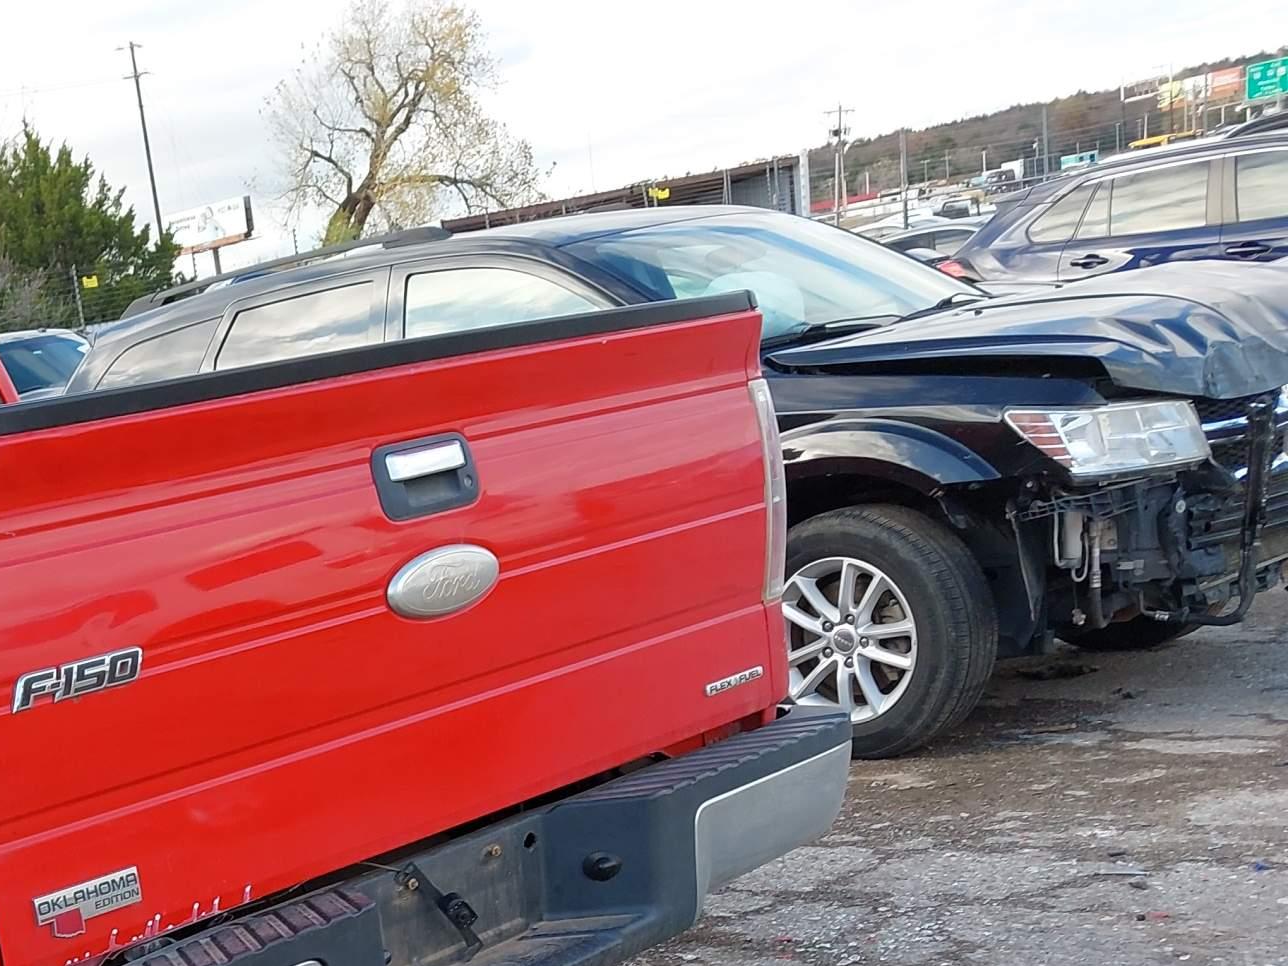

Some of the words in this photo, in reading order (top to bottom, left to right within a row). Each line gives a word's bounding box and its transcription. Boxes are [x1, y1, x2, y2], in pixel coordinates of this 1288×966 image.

[422, 559, 482, 600] Ford
[12, 645, 144, 714] F-150
[709, 679, 733, 694] FLEX
[738, 669, 761, 683] FUEL
[37, 871, 139, 918] OKLAHOMA
[94, 886, 141, 911] EDITION
